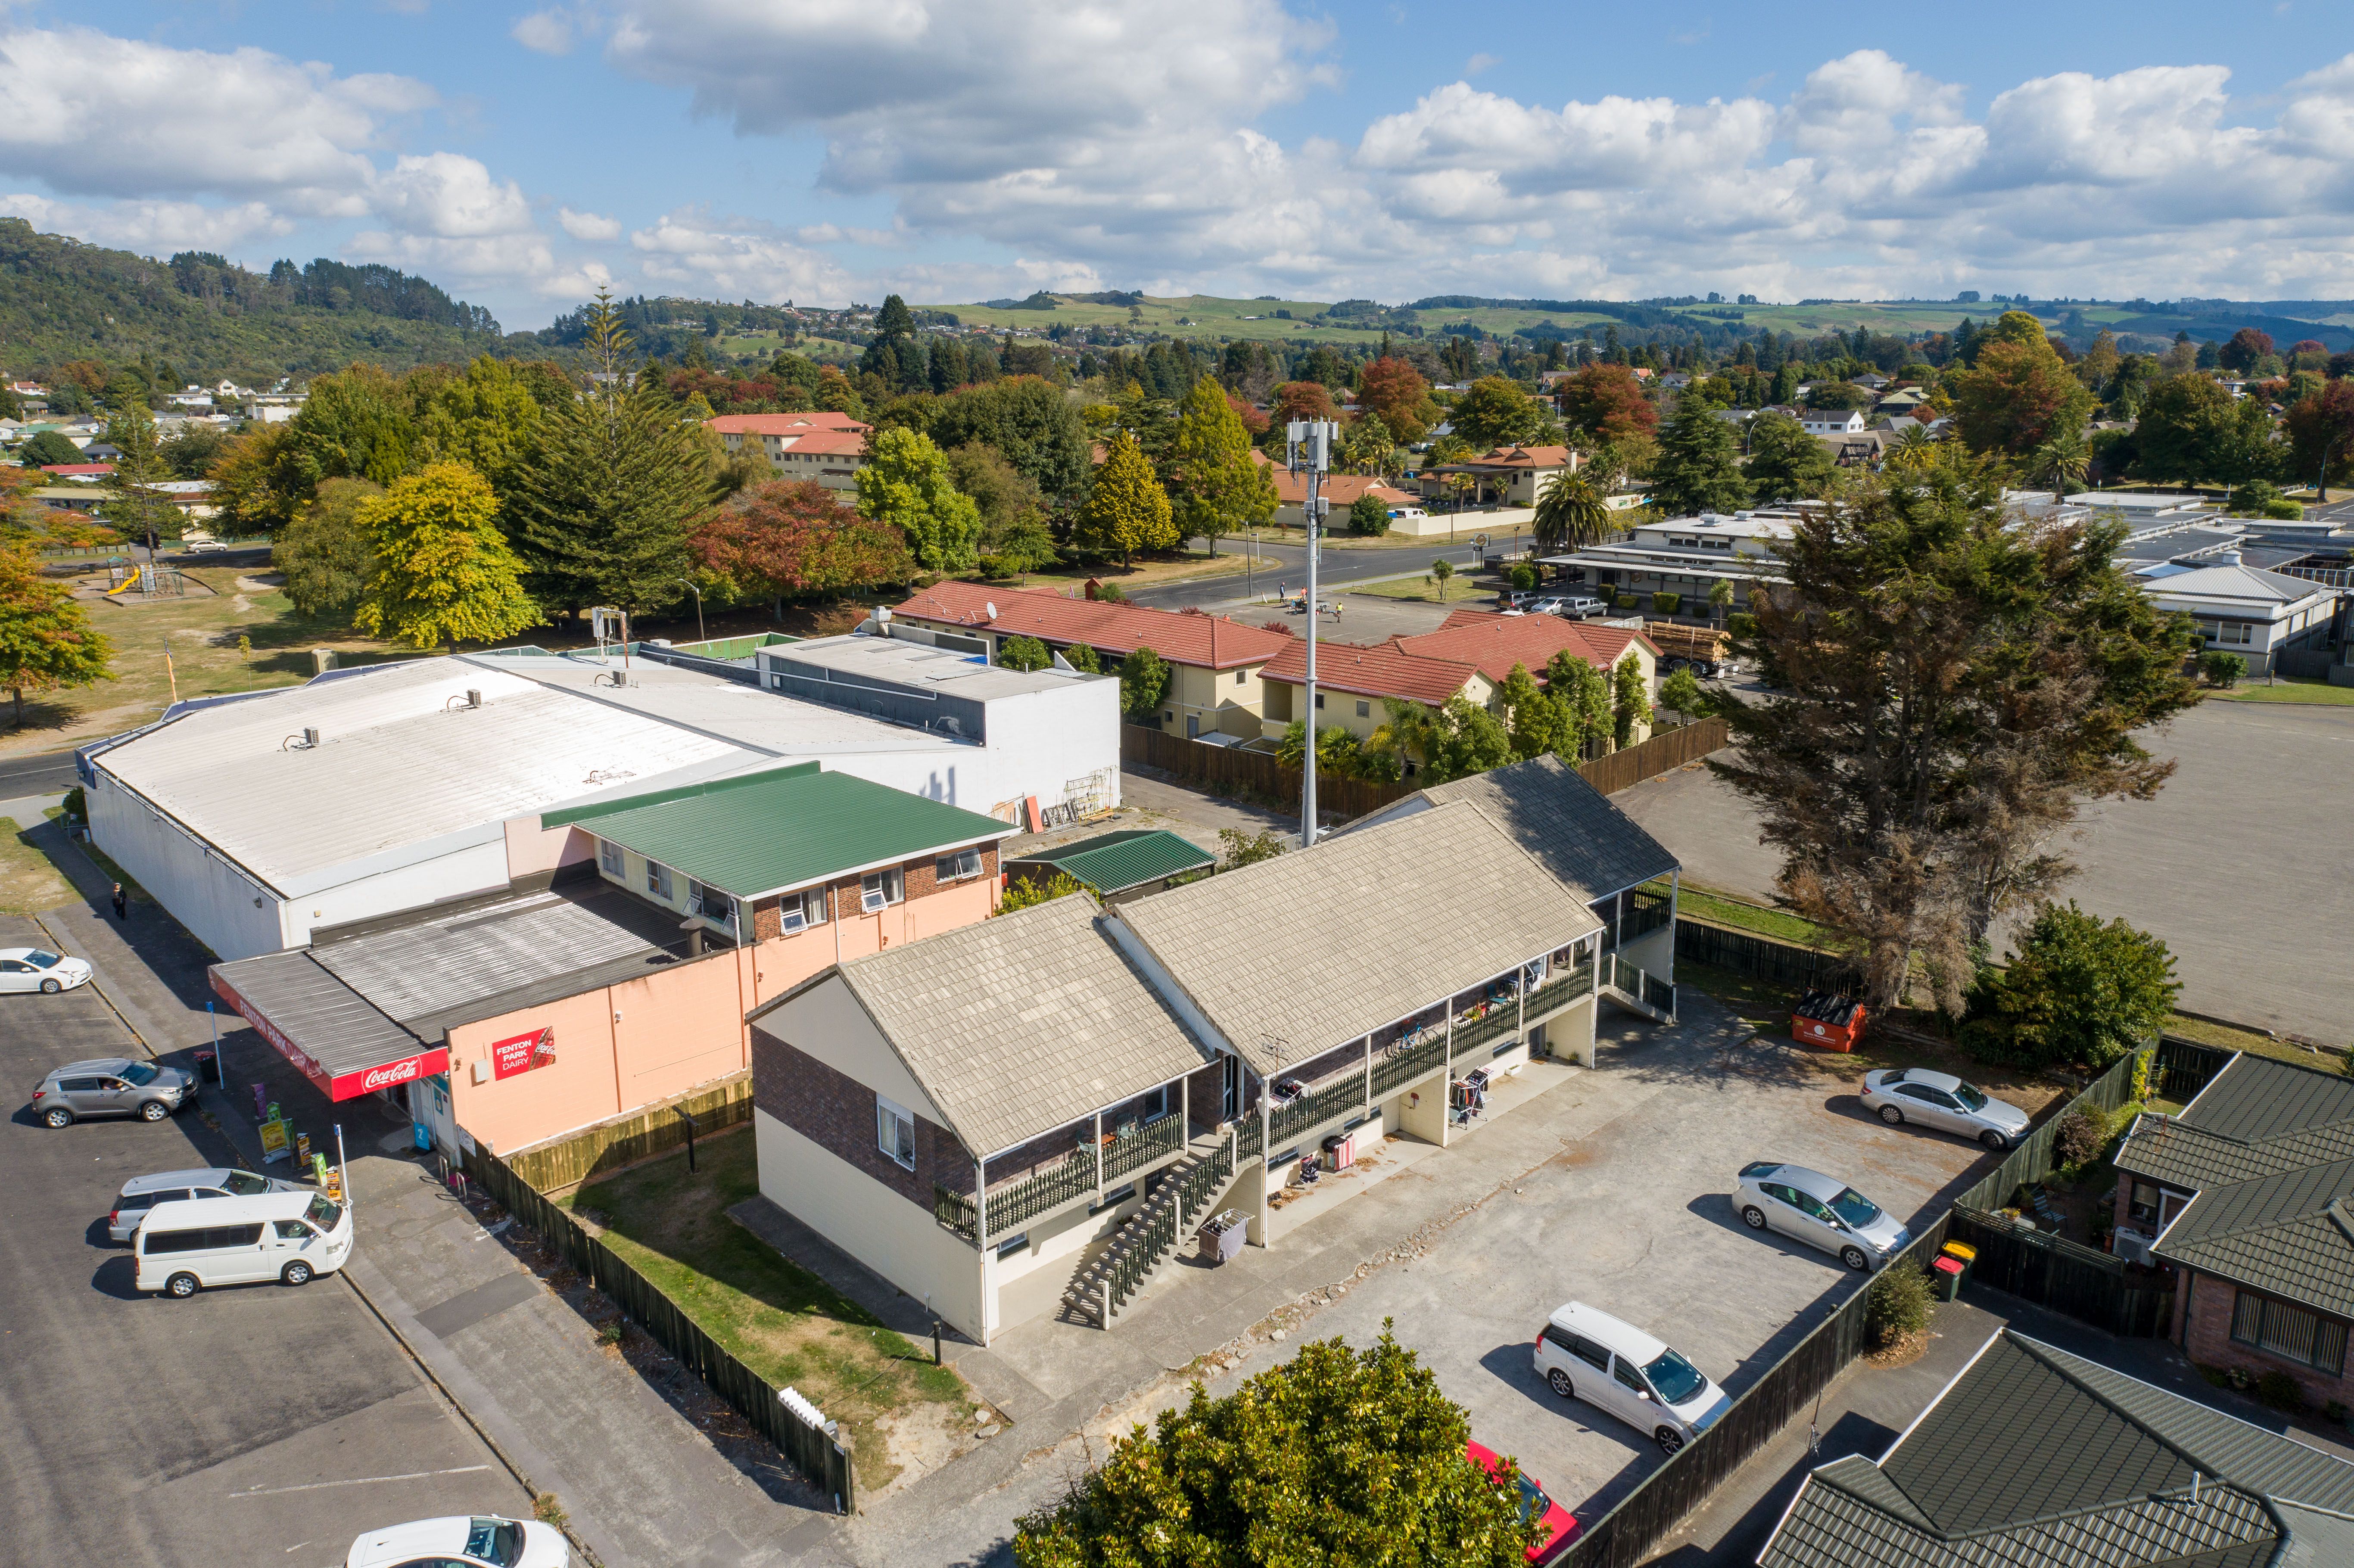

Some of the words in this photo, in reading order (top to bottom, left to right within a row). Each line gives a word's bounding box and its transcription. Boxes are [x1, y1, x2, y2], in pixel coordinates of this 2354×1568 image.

[240, 999, 267, 1034] FENTON
[268, 1025, 288, 1055] PARK
[497, 1039, 532, 1055] FENTON
[503, 1049, 527, 1062] PARK
[503, 1057, 529, 1070] DAIRY
[365, 1059, 418, 1088] Coca-Cola
